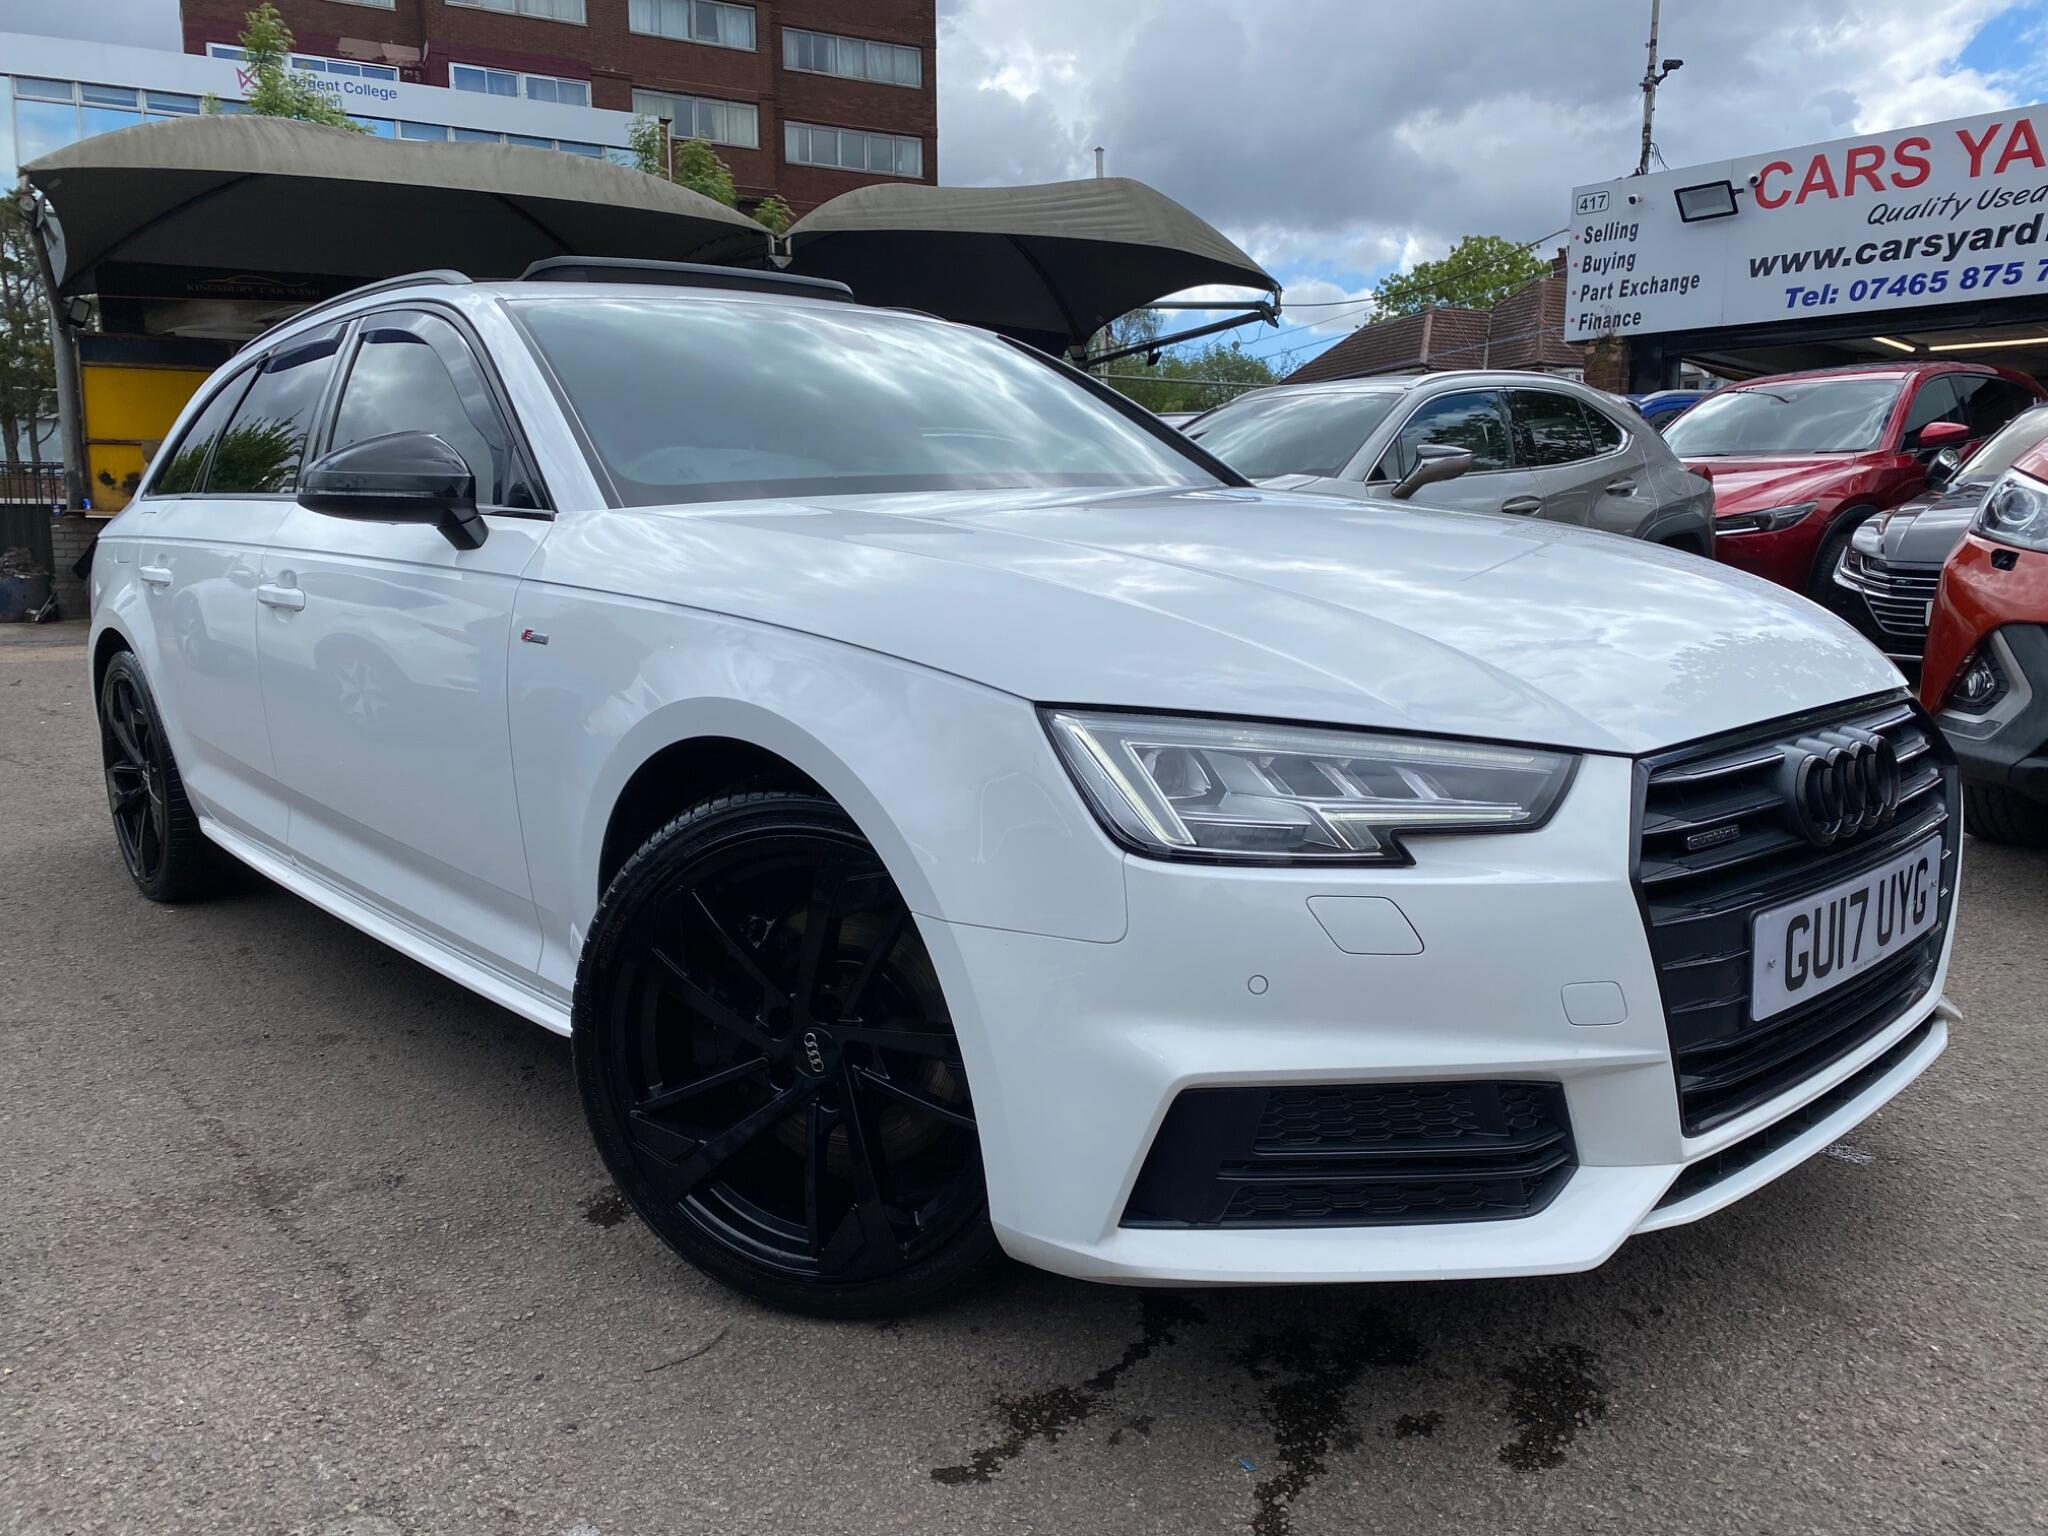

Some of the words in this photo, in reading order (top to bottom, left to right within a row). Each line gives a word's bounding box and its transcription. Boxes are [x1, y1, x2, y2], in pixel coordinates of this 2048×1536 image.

[343, 81, 397, 100] College
[1755, 137, 1932, 209] CARS
[1956, 118, 2046, 178] YA
[1580, 194, 1606, 211] 417
[1867, 192, 1972, 225] Quality
[1584, 221, 1639, 244] Selling
[1749, 212, 2048, 278] www.carsyard
[1582, 252, 1636, 275] Buying
[288, 287, 320, 297] WASH
[1580, 281, 1613, 302] Part
[1619, 274, 1700, 295] Exchange
[1785, 283, 1839, 308] Tel:
[1849, 270, 1949, 302] 07465
[1959, 261, 2024, 290] 875
[1578, 311, 1641, 331] Finance
[1785, 887, 1870, 992] GU17
[1877, 857, 1929, 947] UYG
